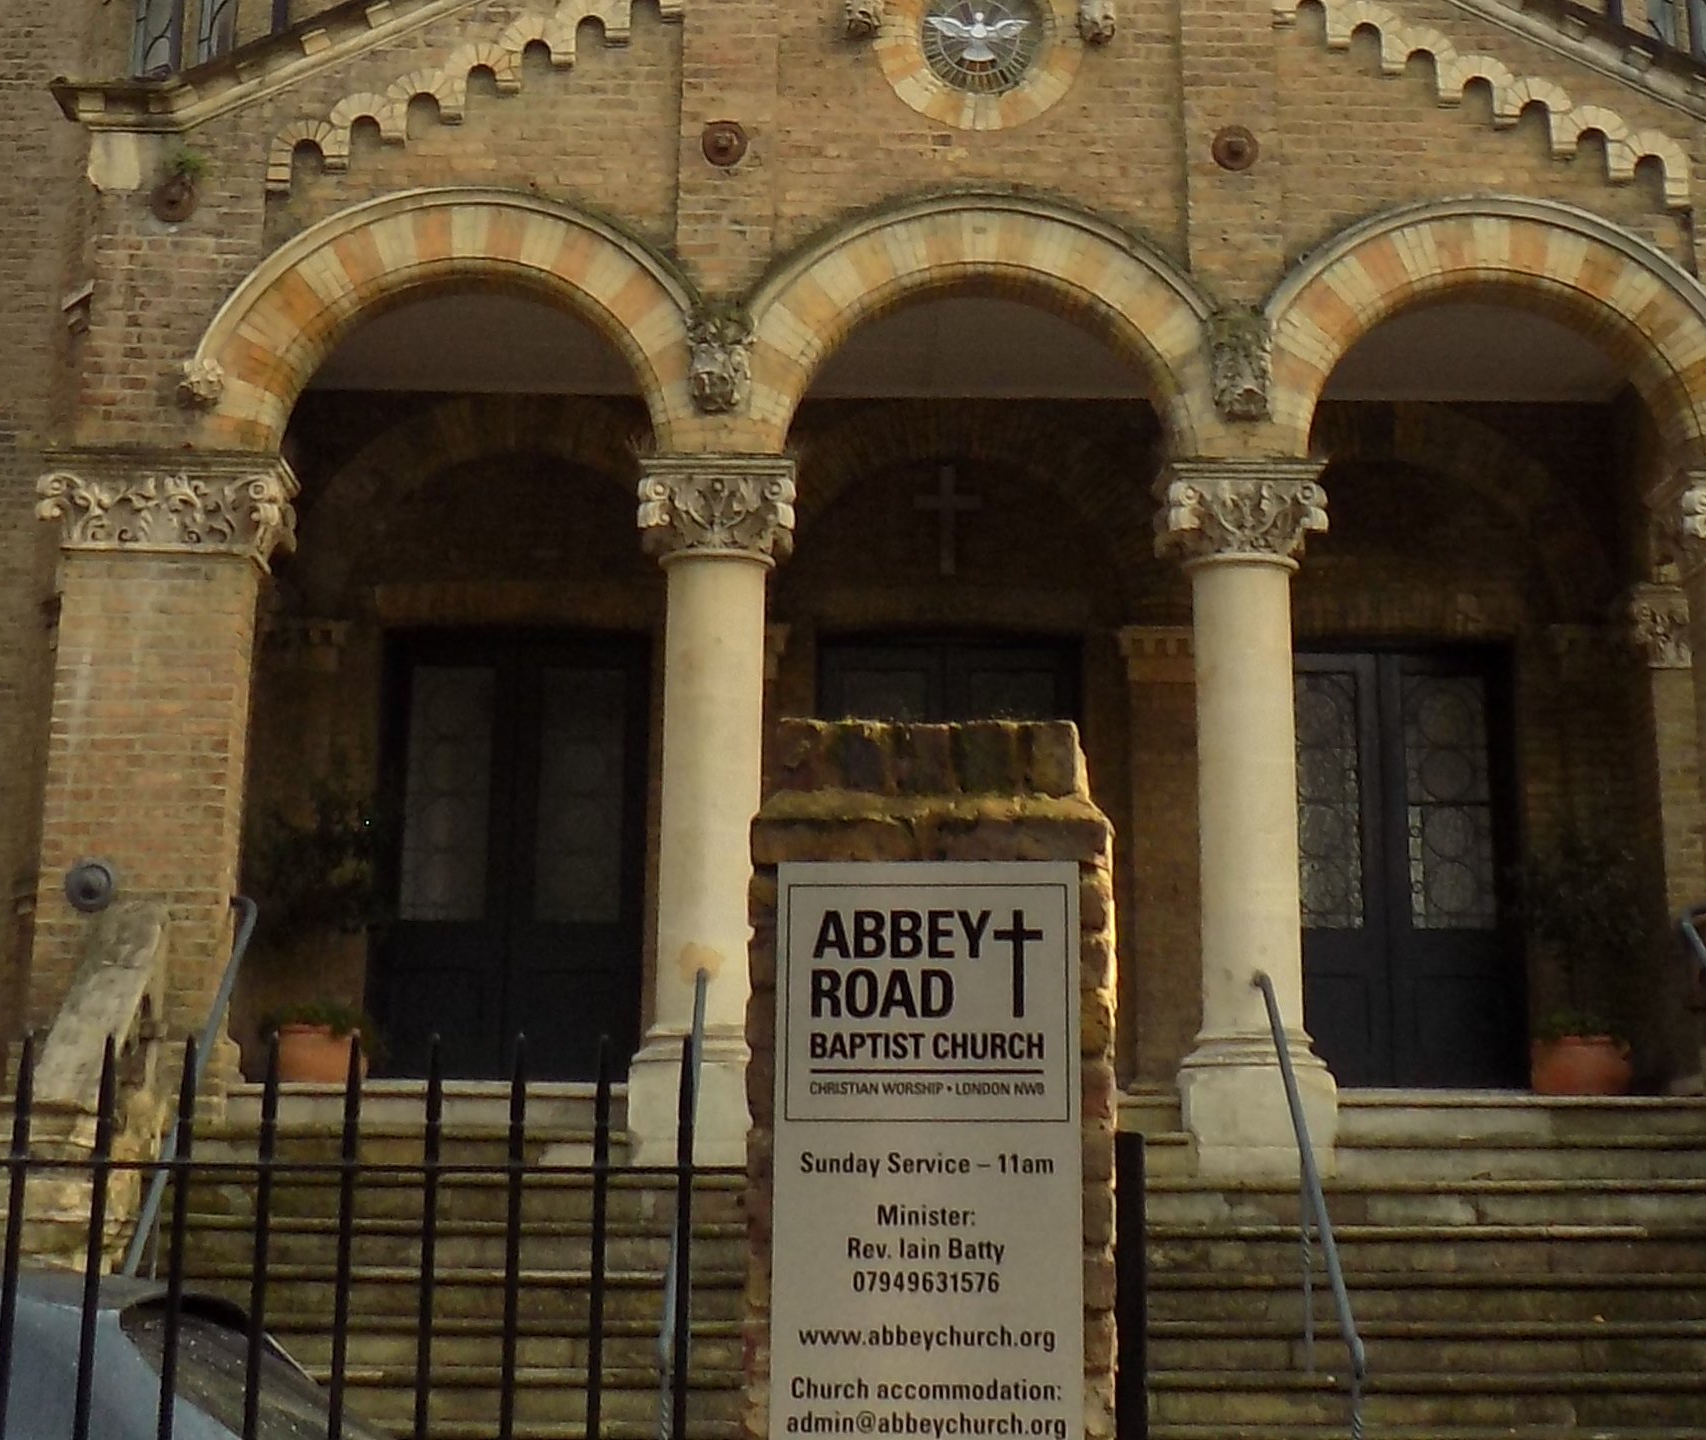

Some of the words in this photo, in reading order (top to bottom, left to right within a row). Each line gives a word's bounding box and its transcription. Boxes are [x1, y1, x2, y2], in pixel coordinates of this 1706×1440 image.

[813, 910, 991, 959] ABBEY
[811, 968, 953, 1019] ROAD
[810, 1032, 925, 1059] BAPTIST
[933, 1032, 1044, 1059] CHURCH
[810, 1081, 878, 1095] CHRISTIAN
[882, 1082, 943, 1095] WORSHIP
[956, 1082, 1010, 1095] LONDON
[801, 1152, 880, 1178] Sunday
[888, 1153, 970, 1174] Service
[998, 1154, 1053, 1174] 11am
[878, 1205, 975, 1226] Minister:
[848, 1237, 891, 1259] Rev.
[900, 1238, 940, 1259] Iain
[949, 1238, 1004, 1265] Batty
[853, 1271, 999, 1293] 07949631576
[799, 1325, 1055, 1352] www.abbeychurch.org
[792, 1377, 868, 1399] Church
[877, 1379, 1061, 1400] accommodation:
[787, 1411, 1066, 1440] admin@abbeychurch.org
